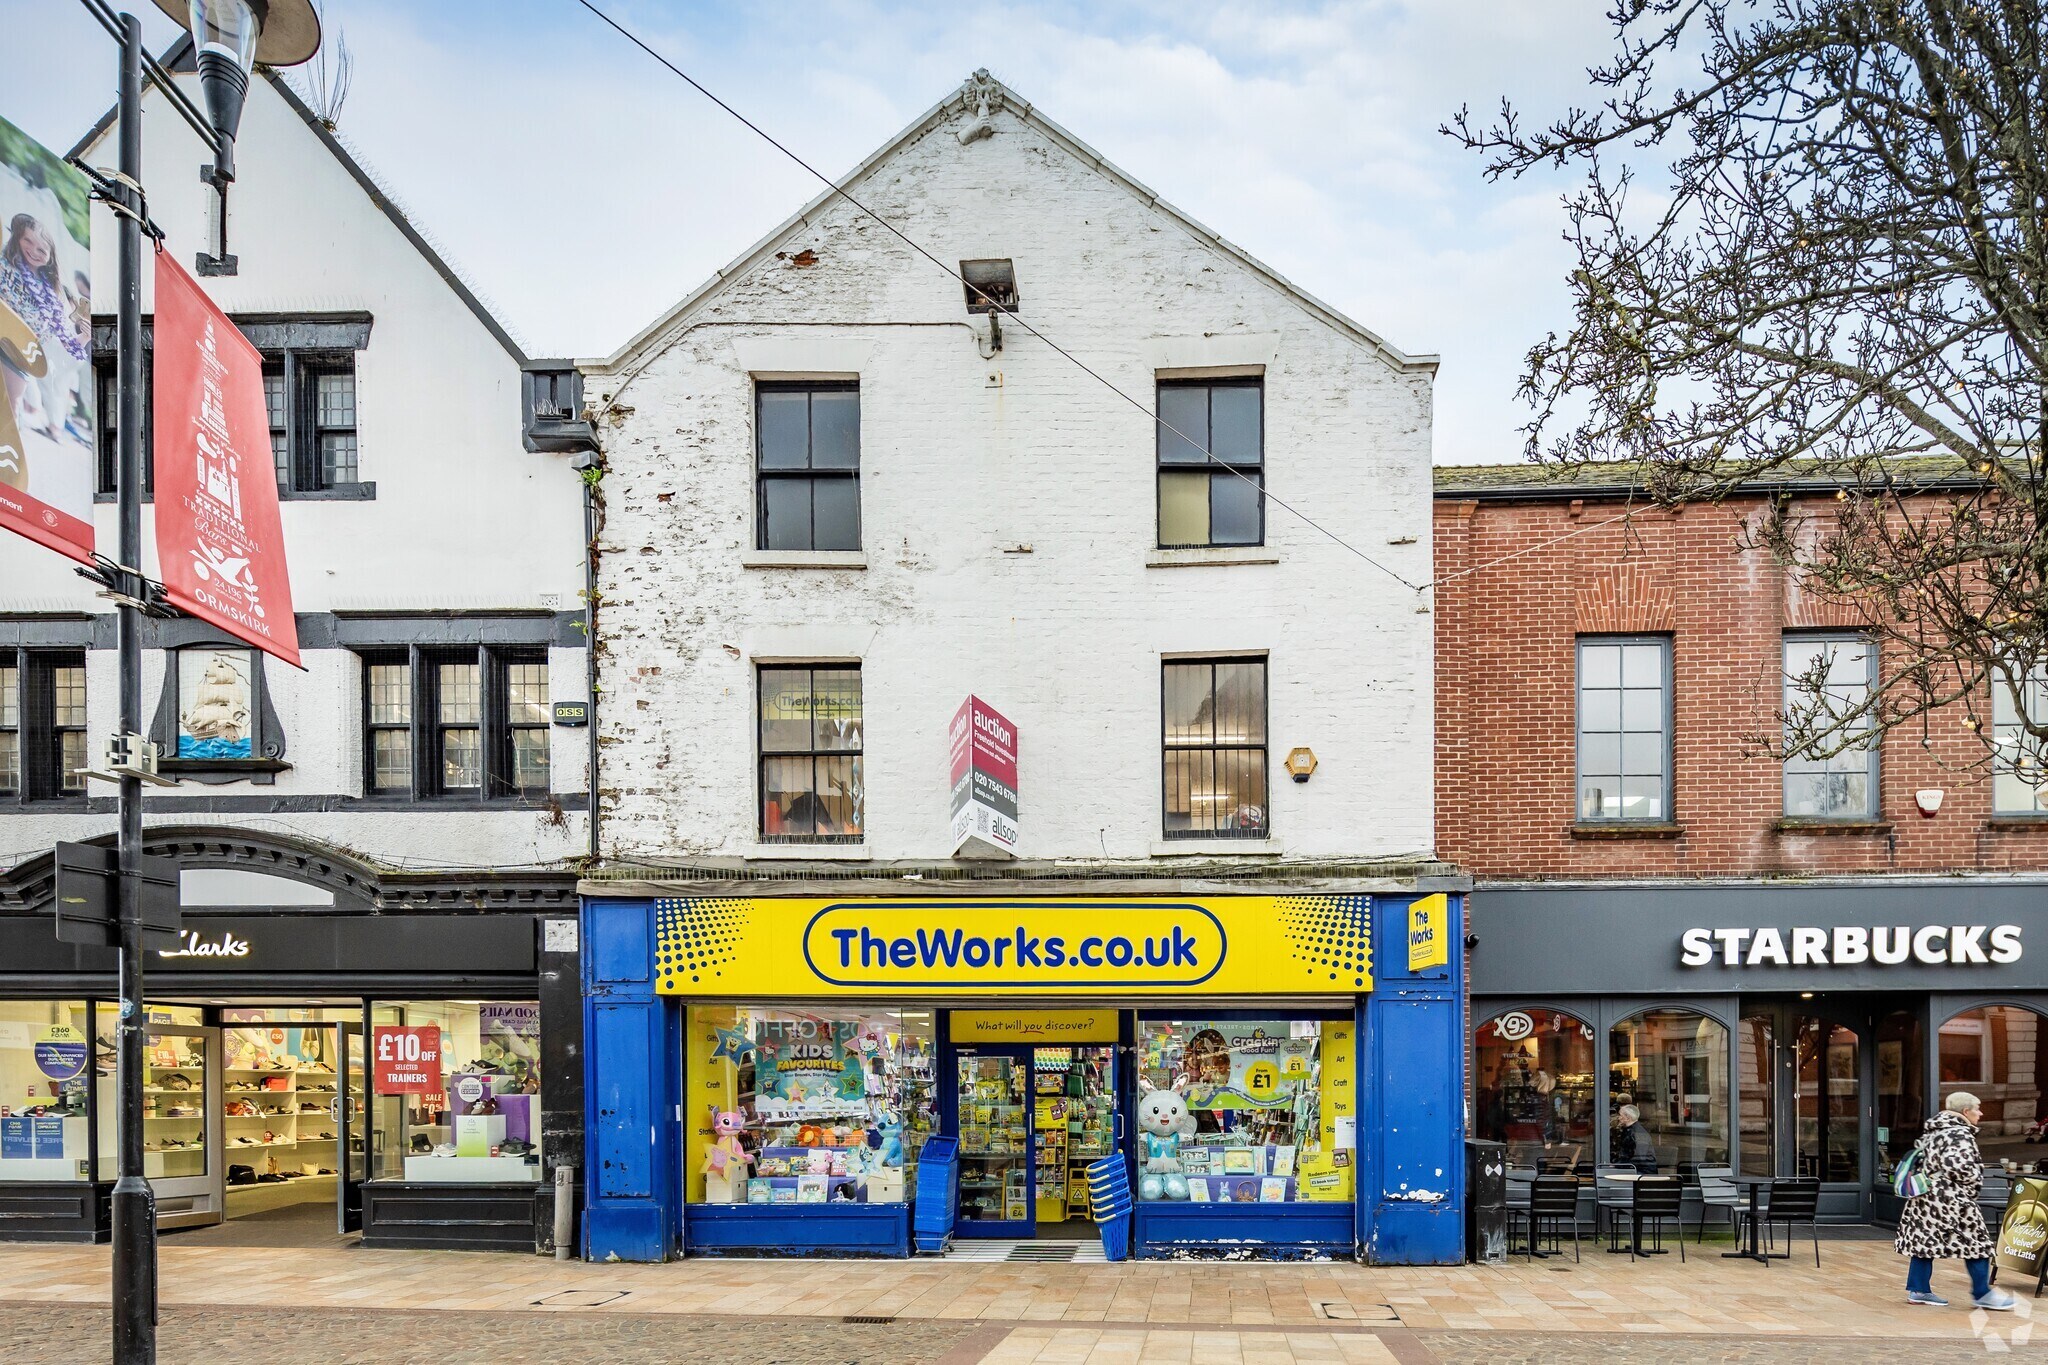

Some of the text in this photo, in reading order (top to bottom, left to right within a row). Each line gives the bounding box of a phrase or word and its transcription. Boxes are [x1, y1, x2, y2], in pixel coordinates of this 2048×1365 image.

[182, 495, 262, 554] TRADITIONAL
[194, 588, 271, 637] ORMSKIRK
[974, 709, 1011, 748] auction
[974, 729, 994, 751] Freehold
[994, 741, 1016, 764] Investment
[974, 771, 1016, 804] 020 7543 6780
[992, 817, 1017, 847] allsop
[1415, 909, 1429, 927] The
[1410, 926, 1433, 946] Works
[831, 924, 1198, 968] TheWorks.co.uk
[1681, 924, 2024, 967] STARBUCKS
[975, 1018, 1095, 1033] What will you discover?
[1334, 1032, 1348, 1040] Gifts
[378, 1034, 421, 1062] £10
[421, 1051, 437, 1062] OFF
[790, 1044, 834, 1059] KIDS
[776, 1059, 846, 1073] FAVOURITES
[1290, 1063, 1301, 1071] £1
[387, 1073, 428, 1083] TRAINERS
[706, 1081, 721, 1089] Craft
[1252, 1074, 1271, 1088] £1
[1333, 1079, 1348, 1087] Craft
[425, 1093, 443, 1102] SALE
[1334, 1102, 1347, 1111] Toys
[1012, 1209, 1023, 1217] £4
[2007, 1216, 2046, 1239] Pistachio
[2012, 1236, 2034, 1249] Velvet
[2004, 1246, 2036, 1261] Oat Latte
